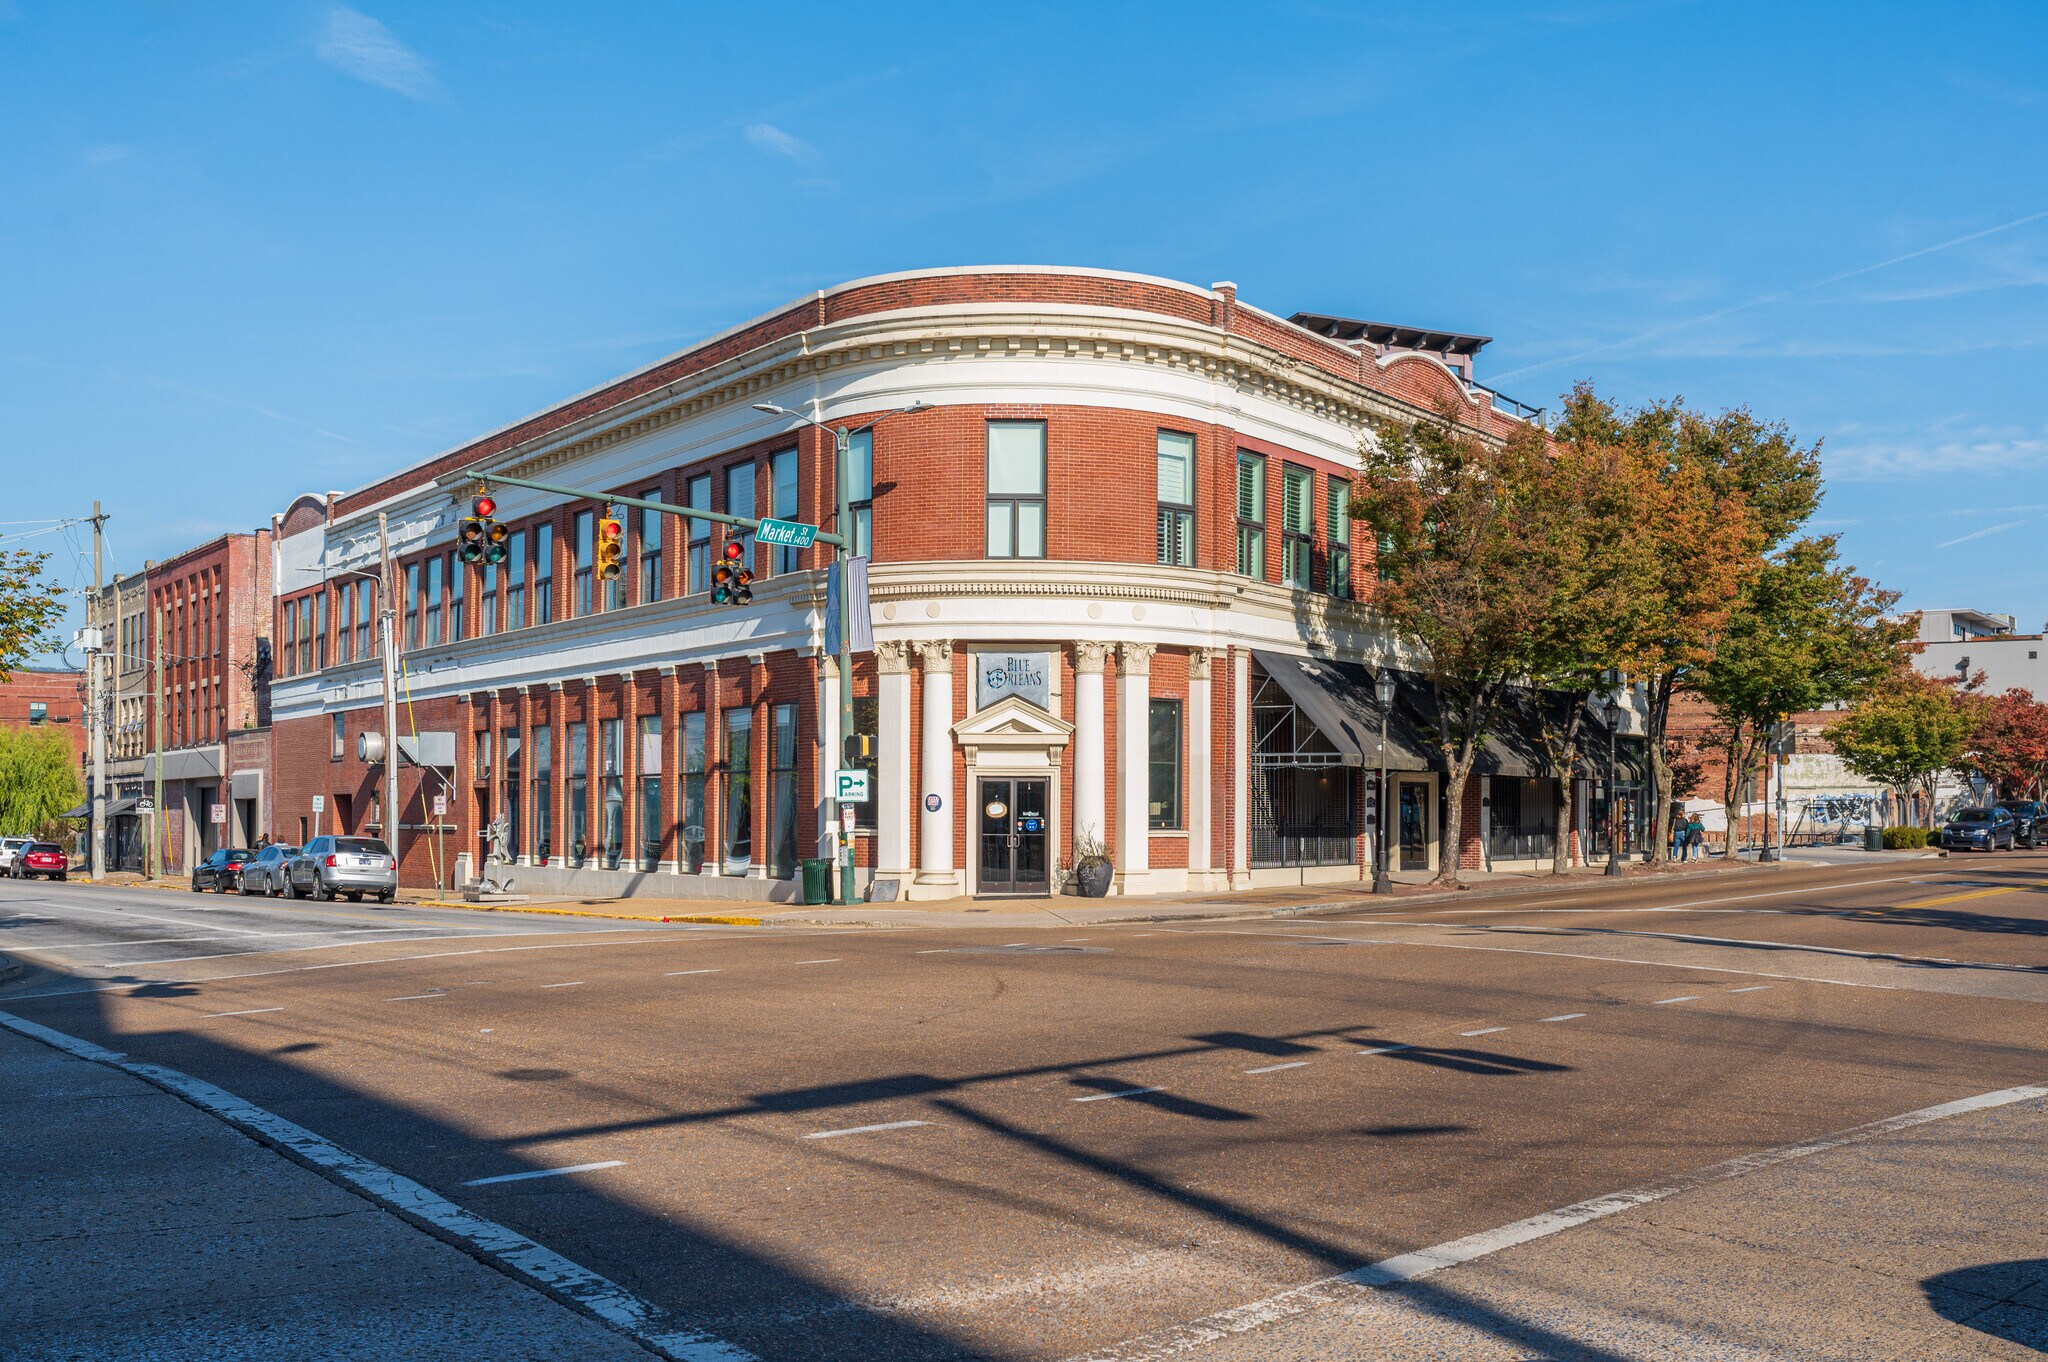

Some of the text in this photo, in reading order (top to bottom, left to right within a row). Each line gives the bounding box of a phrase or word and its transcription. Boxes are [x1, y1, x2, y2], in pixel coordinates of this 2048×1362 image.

[760, 522, 796, 543] Market
[801, 527, 808, 535] St
[793, 536, 809, 546] 1400
[1007, 657, 1030, 671] BLUE
[986, 668, 1042, 689] ORLEANS
